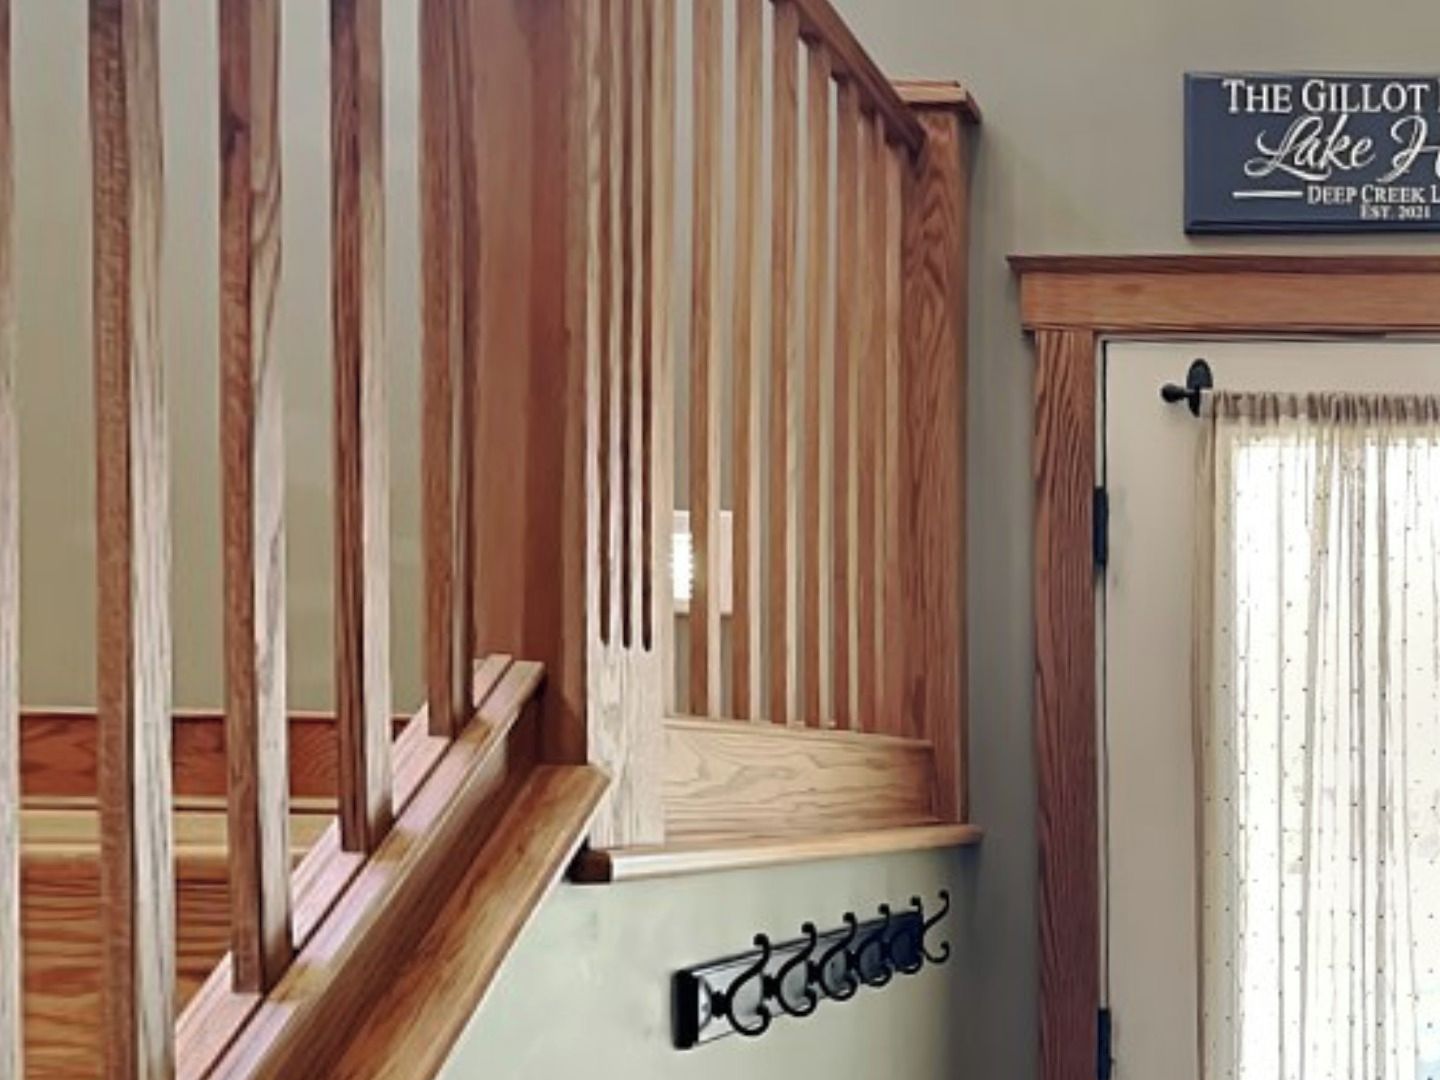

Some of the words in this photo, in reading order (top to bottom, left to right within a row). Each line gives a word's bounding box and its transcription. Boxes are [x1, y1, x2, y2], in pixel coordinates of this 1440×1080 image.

[1222, 79, 1292, 113] THE
[1302, 79, 1430, 113] GILLOT
[1244, 113, 1376, 181] Lake
[1307, 184, 1357, 203] DEEP
[1361, 184, 1426, 203] CREEK
[1360, 204, 1392, 219] EST.
[1398, 204, 1431, 219] 2021
